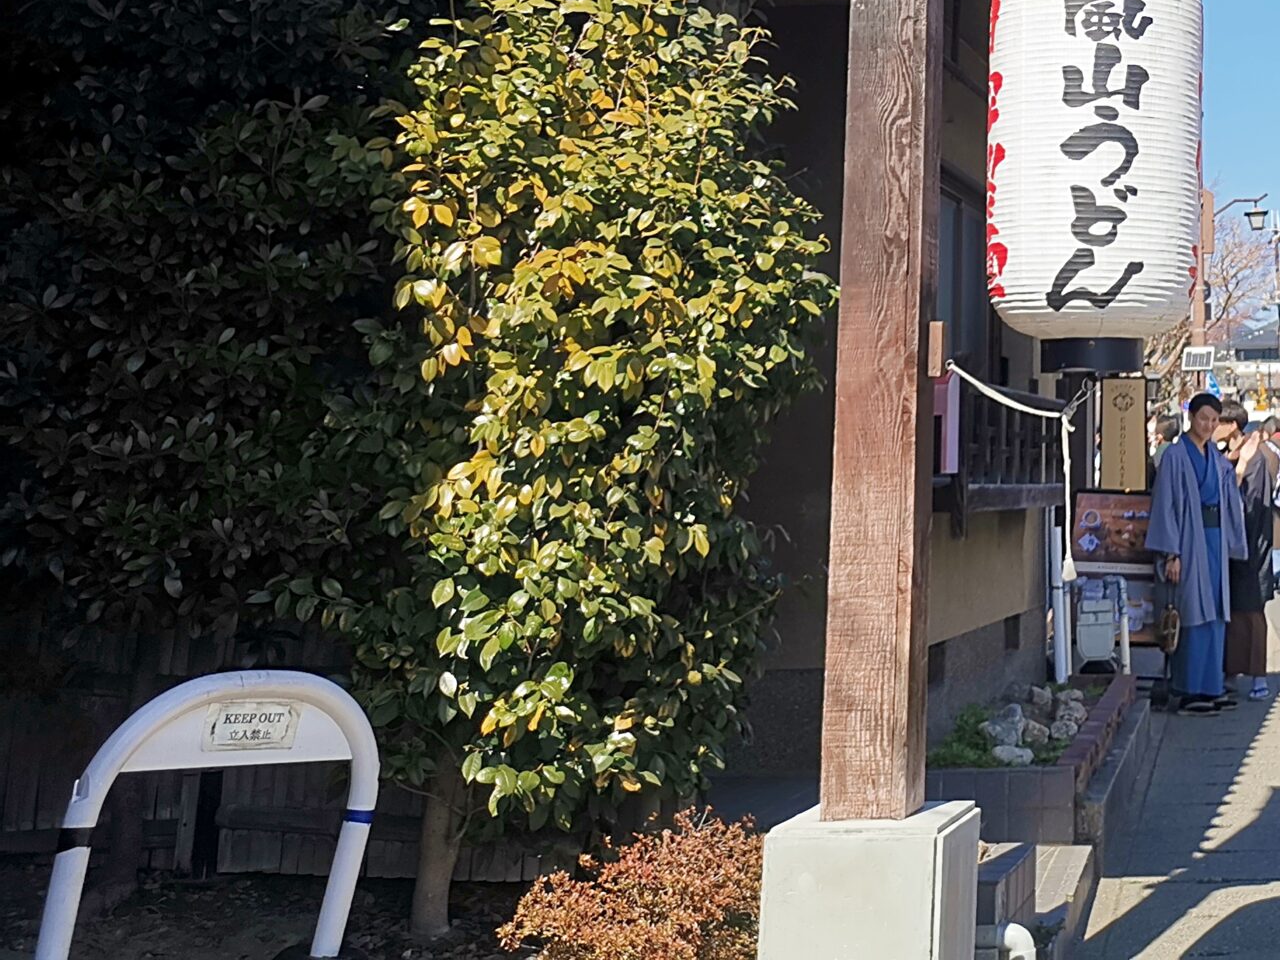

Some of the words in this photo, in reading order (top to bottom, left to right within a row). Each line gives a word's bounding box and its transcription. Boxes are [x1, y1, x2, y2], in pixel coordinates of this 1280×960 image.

[223, 713, 257, 724] KEEP
[258, 712, 284, 723] OUT
[229, 729, 272, 741] 立入禁止
